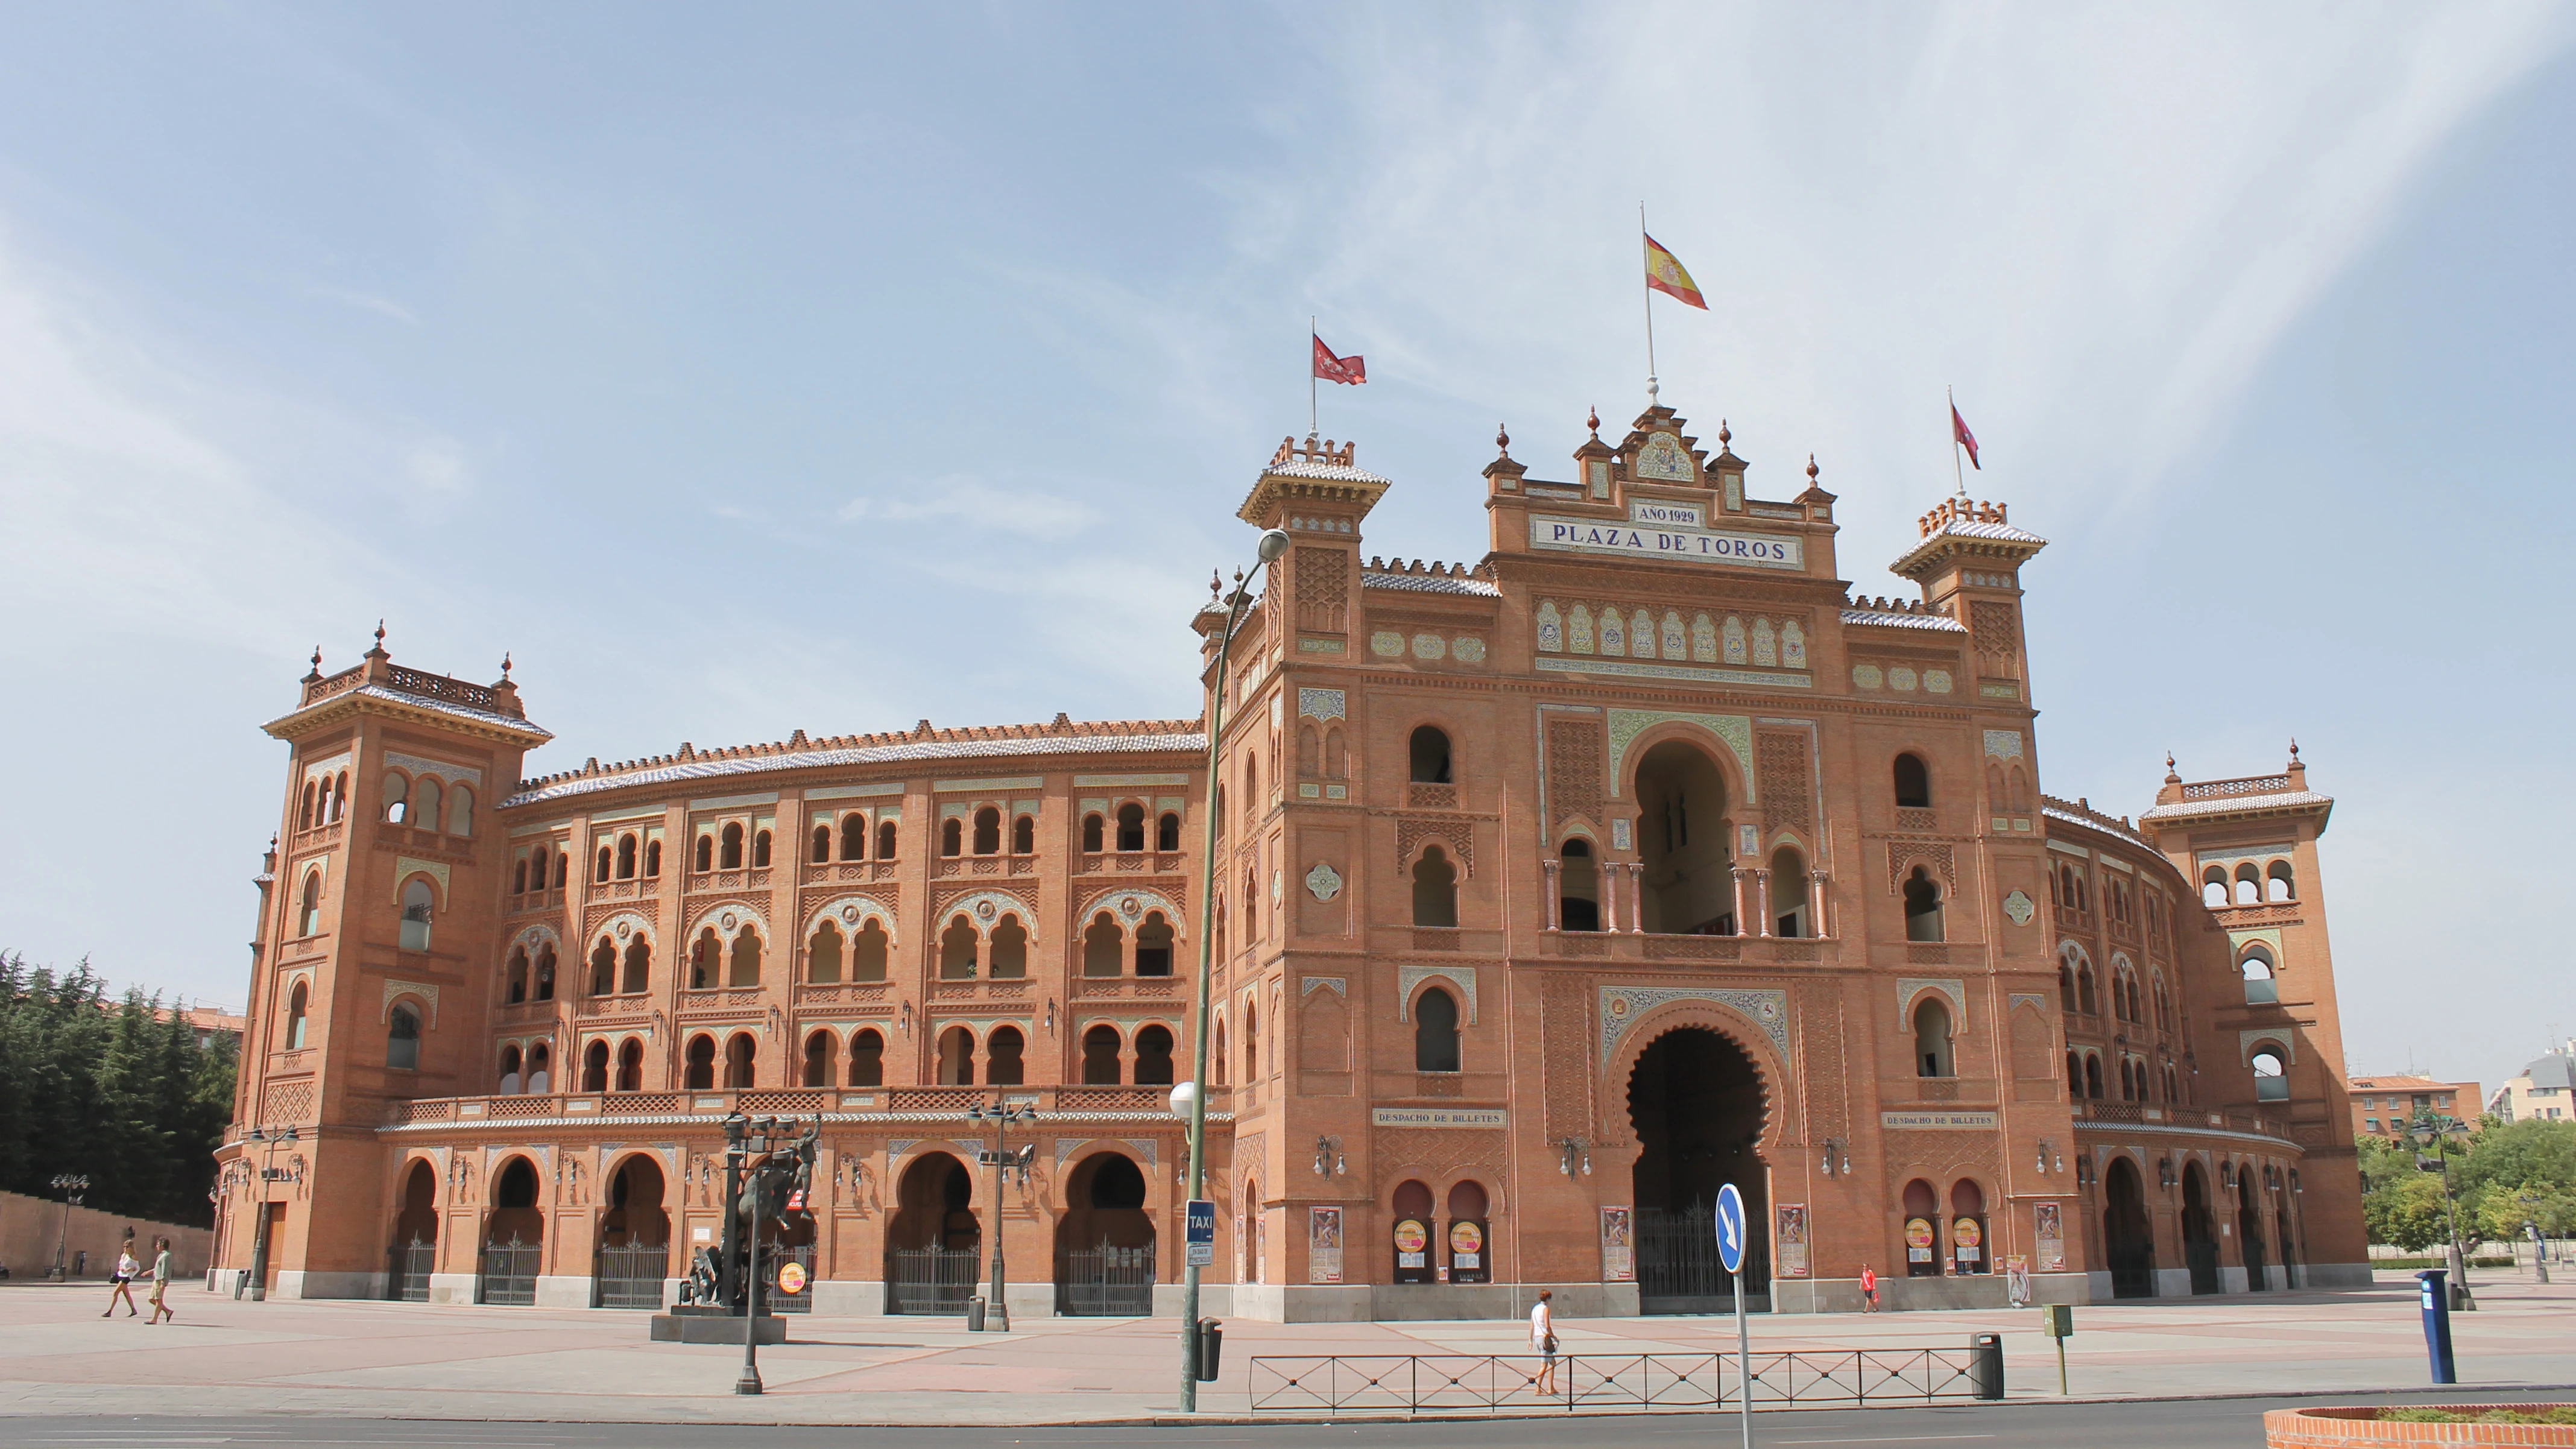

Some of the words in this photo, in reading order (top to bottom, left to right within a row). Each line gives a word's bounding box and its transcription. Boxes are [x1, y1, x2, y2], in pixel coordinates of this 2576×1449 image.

[1640, 506, 1666, 520] AÑO
[1669, 510, 1694, 523] 1929
[1553, 525, 1643, 548] PLAZA
[1658, 534, 1686, 551] DE
[1697, 537, 1784, 559] TOROS
[1189, 1216, 1213, 1228] TAXI
